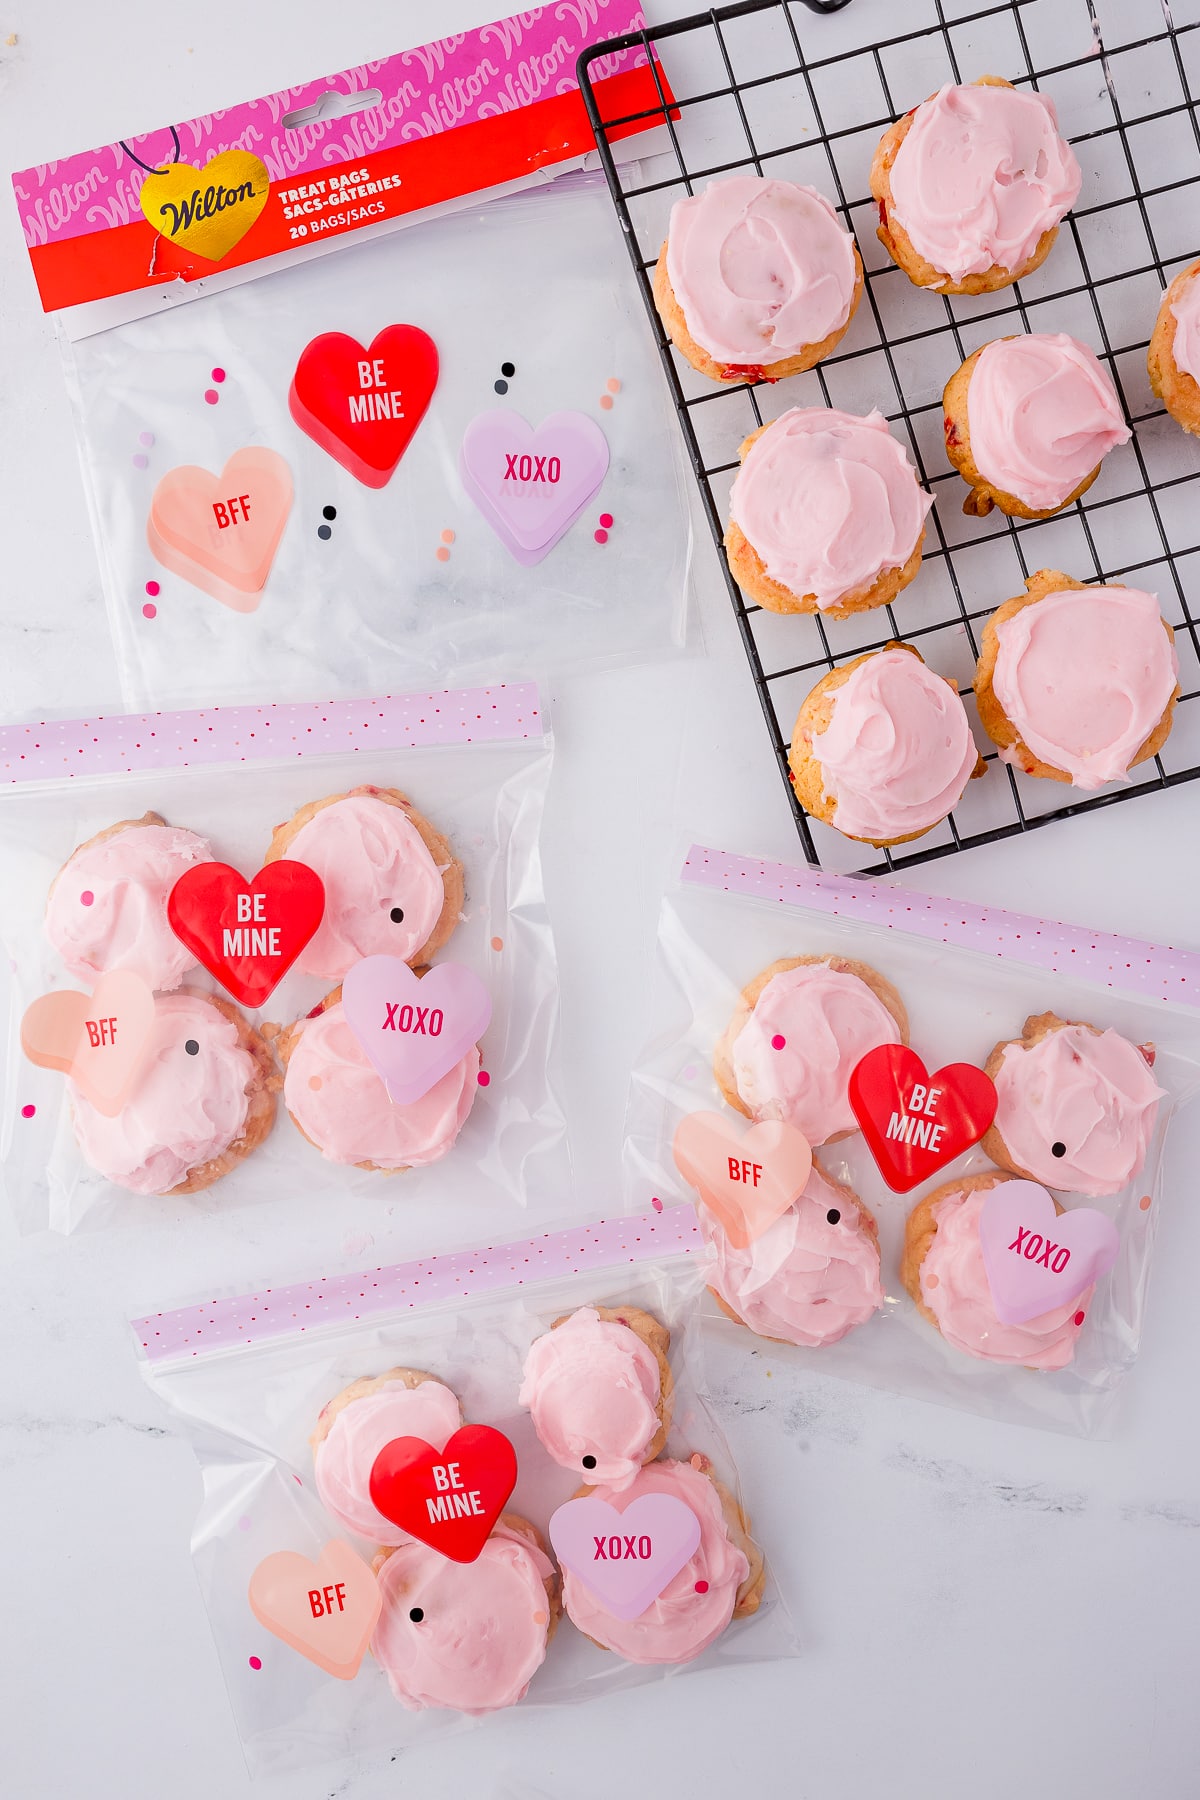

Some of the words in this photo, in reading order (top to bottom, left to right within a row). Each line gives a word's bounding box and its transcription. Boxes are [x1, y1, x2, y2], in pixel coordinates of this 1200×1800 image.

[401, 58, 500, 140] Wilton
[322, 80, 422, 162] Wilton
[278, 181, 326, 204] TREAT
[328, 168, 370, 190] BAGS
[283, 174, 402, 220] SACS-GÂTERIES
[160, 181, 256, 236] Wilton
[289, 225, 308, 240] 20
[310, 201, 386, 233] BAGS/SACS
[358, 360, 387, 388] BE
[349, 391, 405, 423] MINE
[503, 453, 561, 483] XOXO
[212, 495, 251, 529] BFF
[237, 893, 267, 922] BE
[223, 928, 282, 957] MINE
[85, 1017, 118, 1048] BFF
[382, 1003, 444, 1037] XOXO
[908, 1083, 943, 1117] BE
[885, 1112, 947, 1153] MINE
[728, 1157, 763, 1187] BFF
[1008, 1226, 1071, 1274] XOXO
[432, 1462, 465, 1491] BE
[426, 1490, 485, 1524] MINE
[593, 1535, 652, 1561] XOXO
[308, 1583, 347, 1618] BFF
